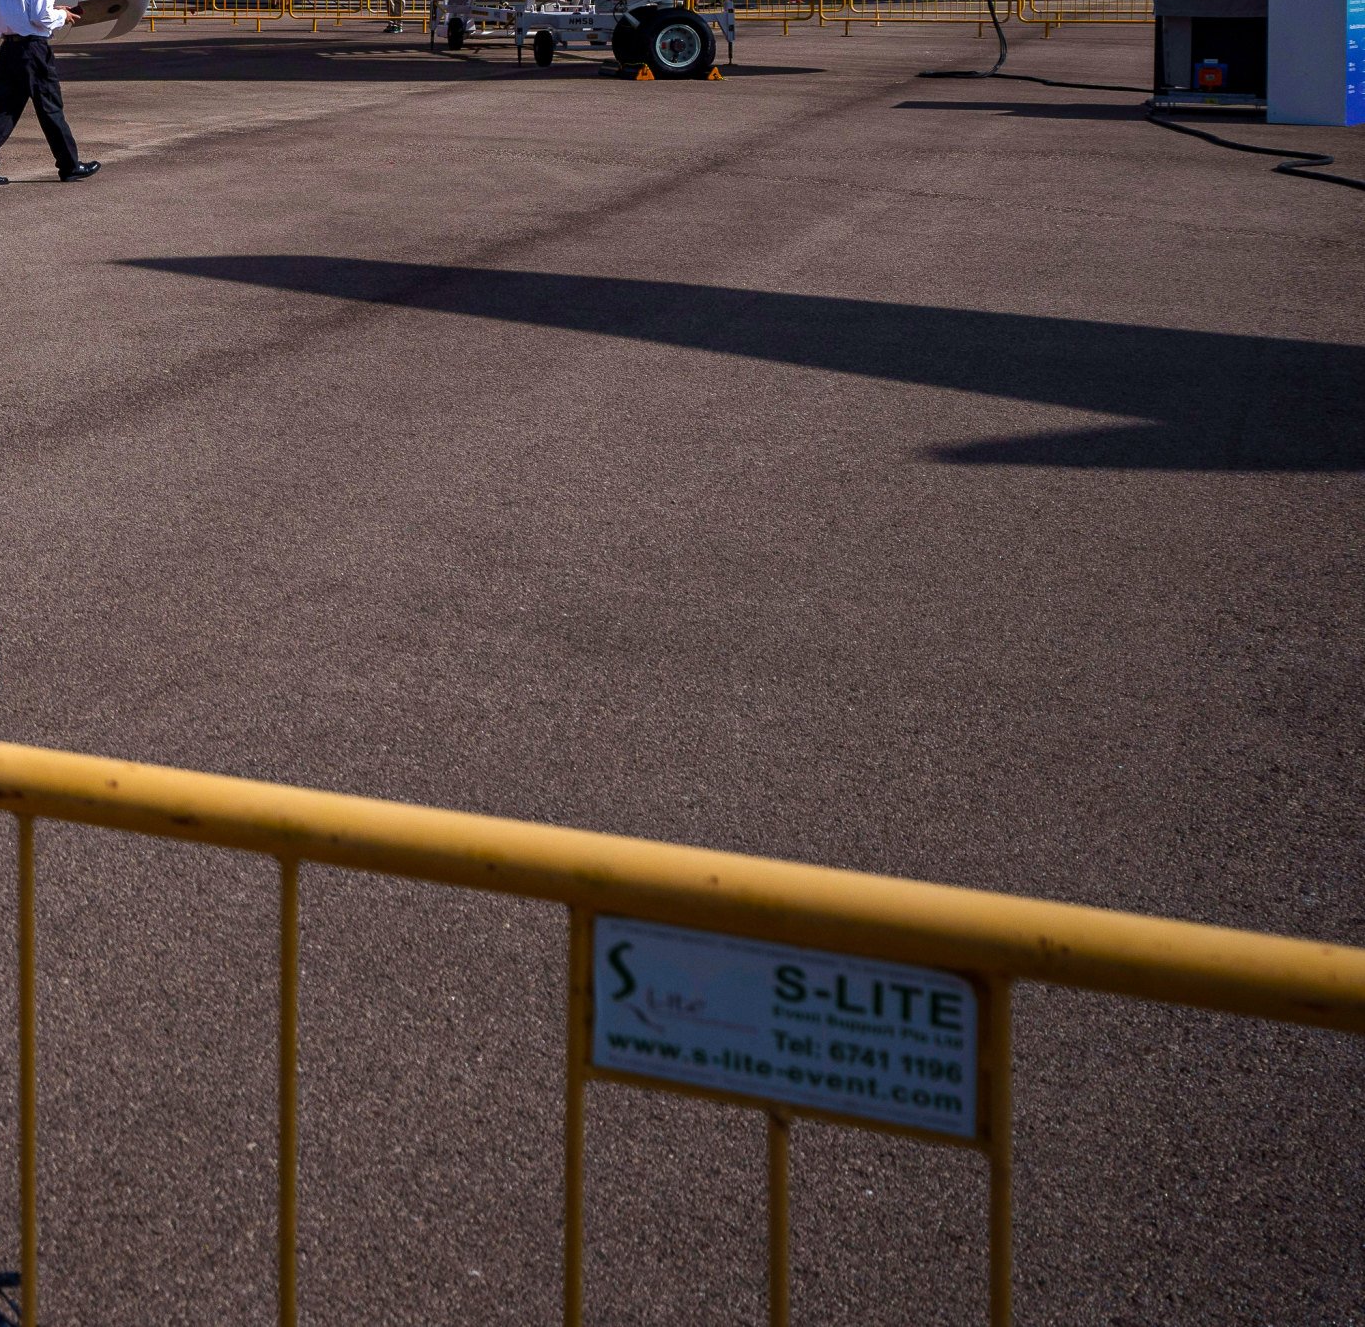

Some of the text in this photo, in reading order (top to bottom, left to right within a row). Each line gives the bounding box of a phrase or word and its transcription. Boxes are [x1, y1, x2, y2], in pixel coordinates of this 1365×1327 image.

[606, 940, 637, 1003] S
[773, 963, 965, 1032] S-LITE
[771, 1005, 822, 1025] Event
[826, 1013, 896, 1039] Support
[606, 1030, 964, 1114] www.s-lite-event.com
[772, 1029, 964, 1085] Tel: 6741 1196
